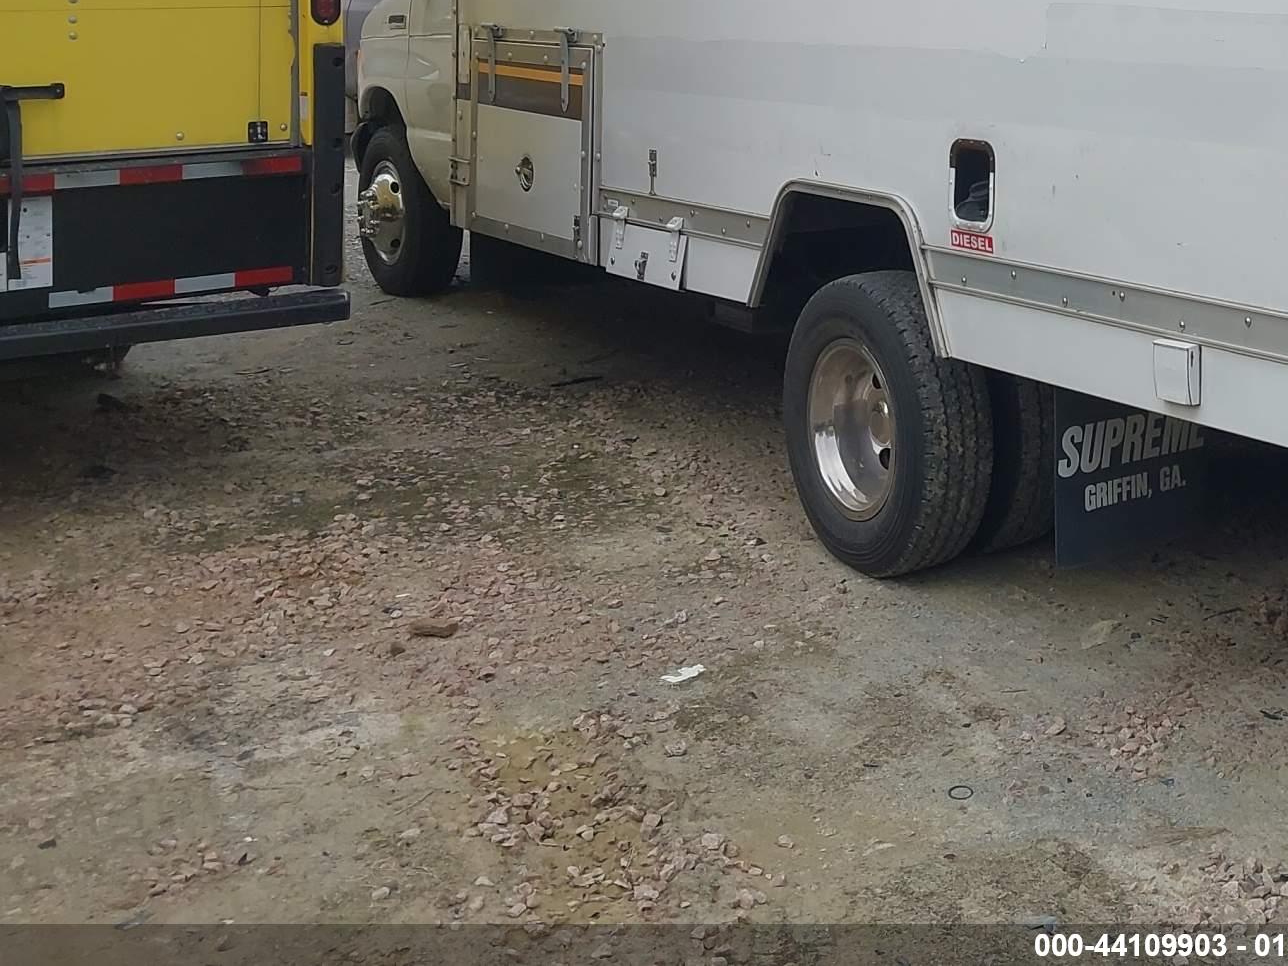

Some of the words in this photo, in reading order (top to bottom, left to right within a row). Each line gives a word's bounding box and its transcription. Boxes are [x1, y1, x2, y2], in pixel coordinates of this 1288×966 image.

[951, 232, 993, 252] DIESEL
[1084, 472, 1153, 513] GRIFFIN,
[1159, 464, 1187, 493] GA.
